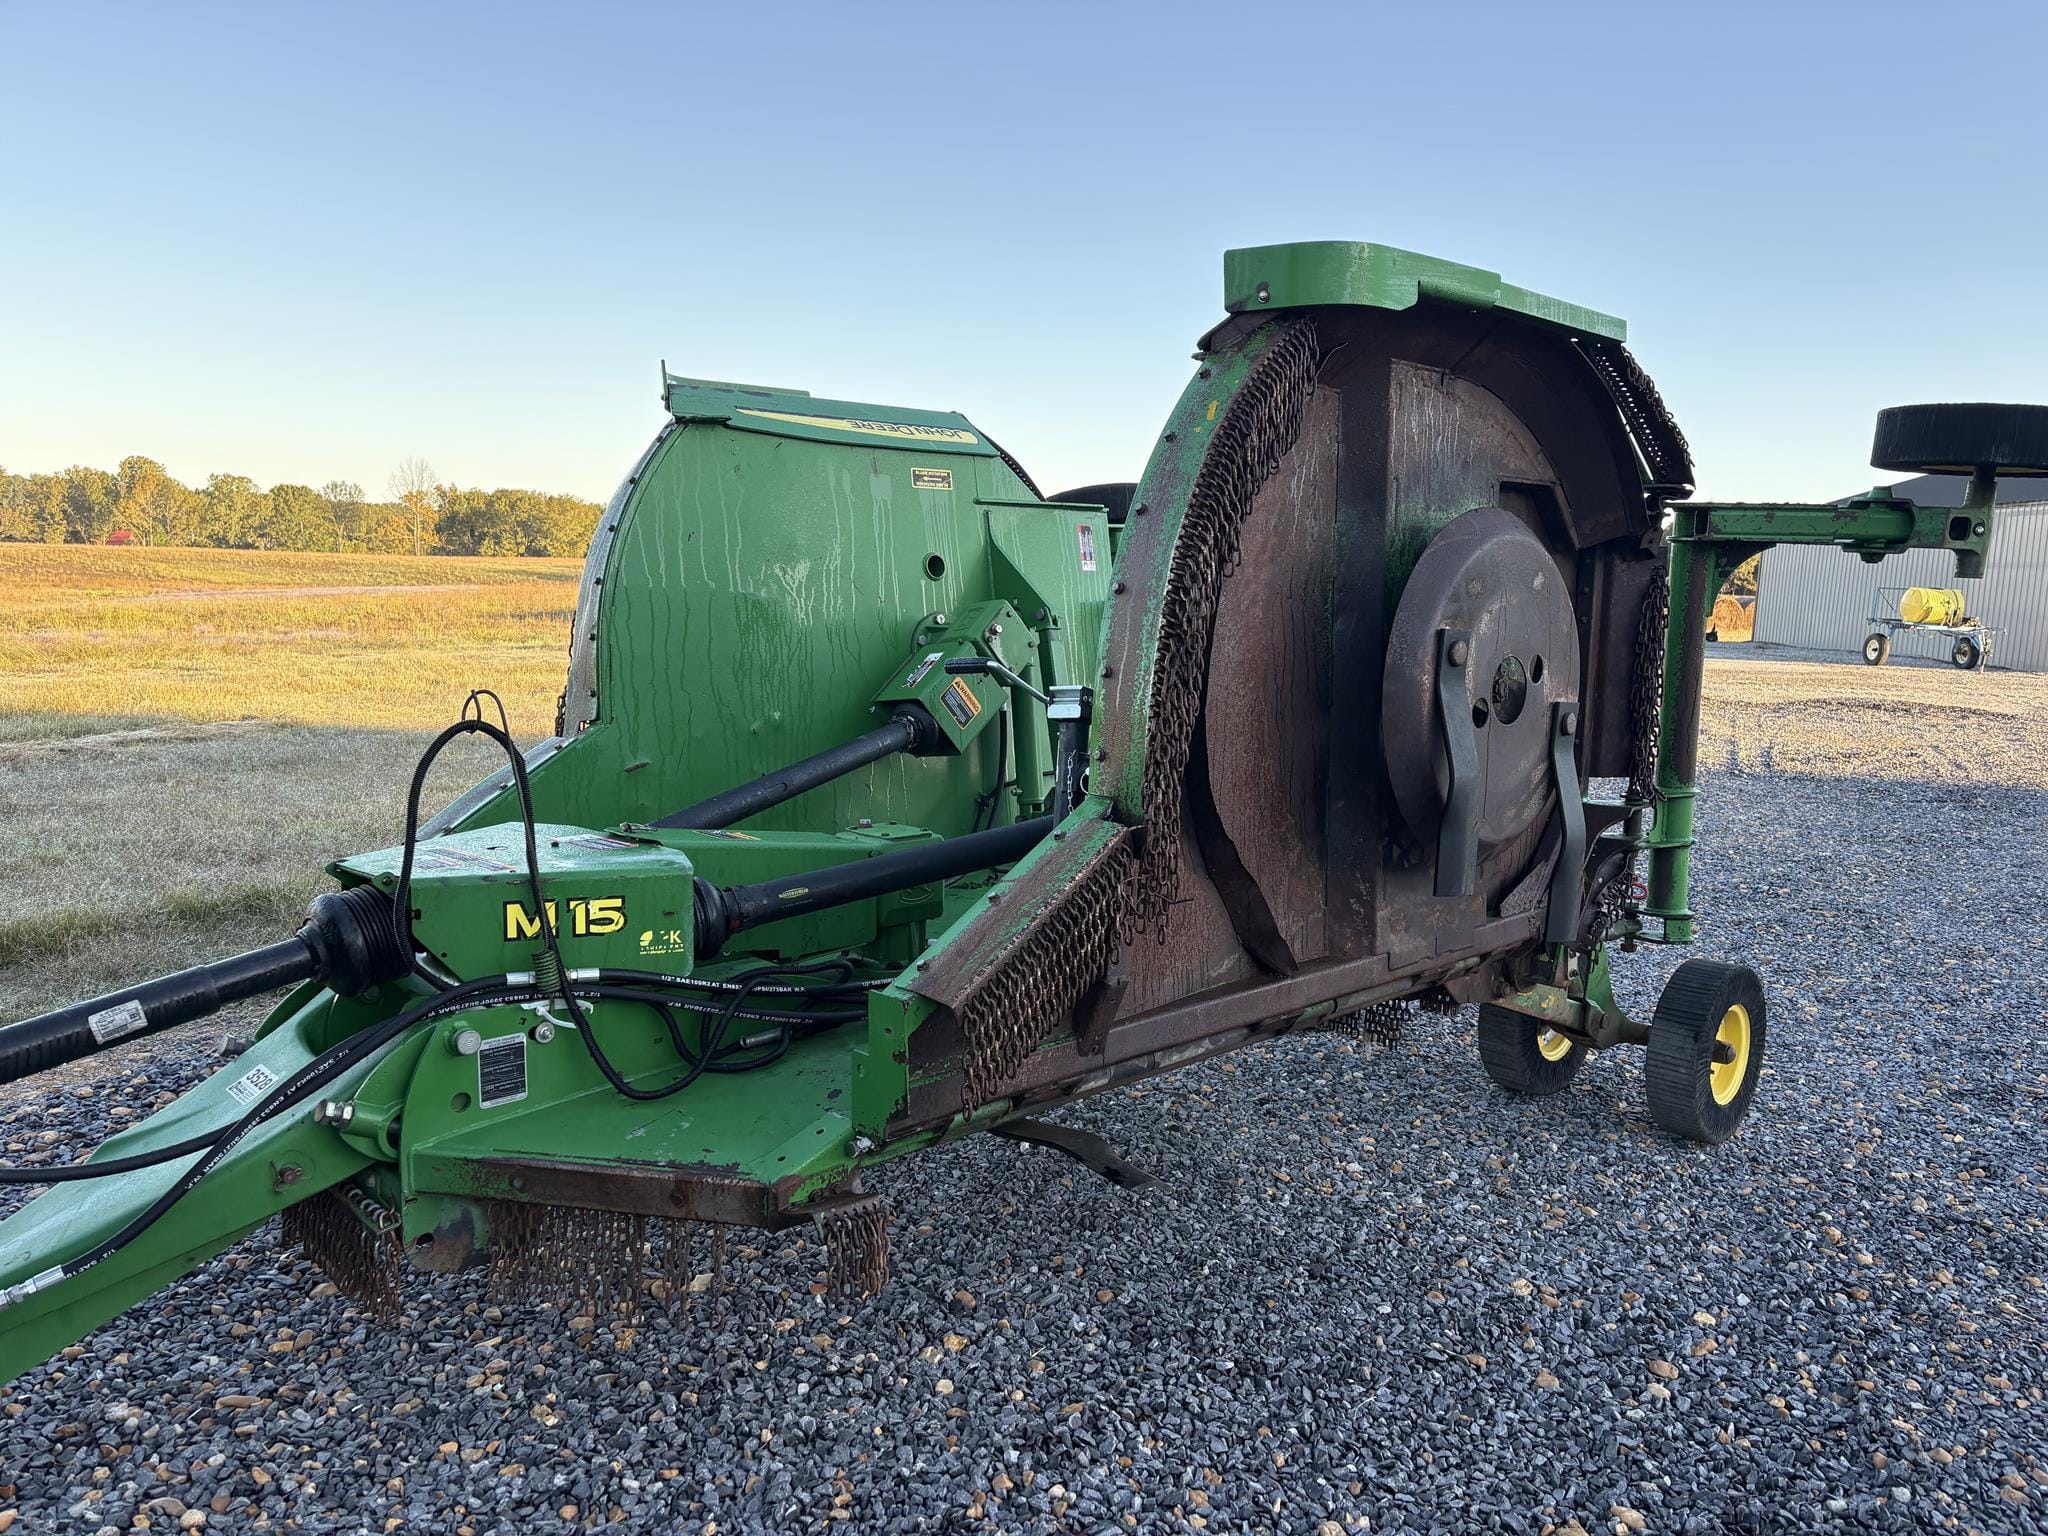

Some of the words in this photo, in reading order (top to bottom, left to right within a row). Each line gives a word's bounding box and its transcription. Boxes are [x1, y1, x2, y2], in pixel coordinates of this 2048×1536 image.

[845, 419, 915, 436] DEERE
[915, 425, 962, 439] JOHN
[959, 685, 980, 713] WARNING
[505, 994, 530, 1002] EN853
[246, 1069, 273, 1091] 3528
[260, 1096, 285, 1117] EN853
[184, 1175, 202, 1189] W.P.
